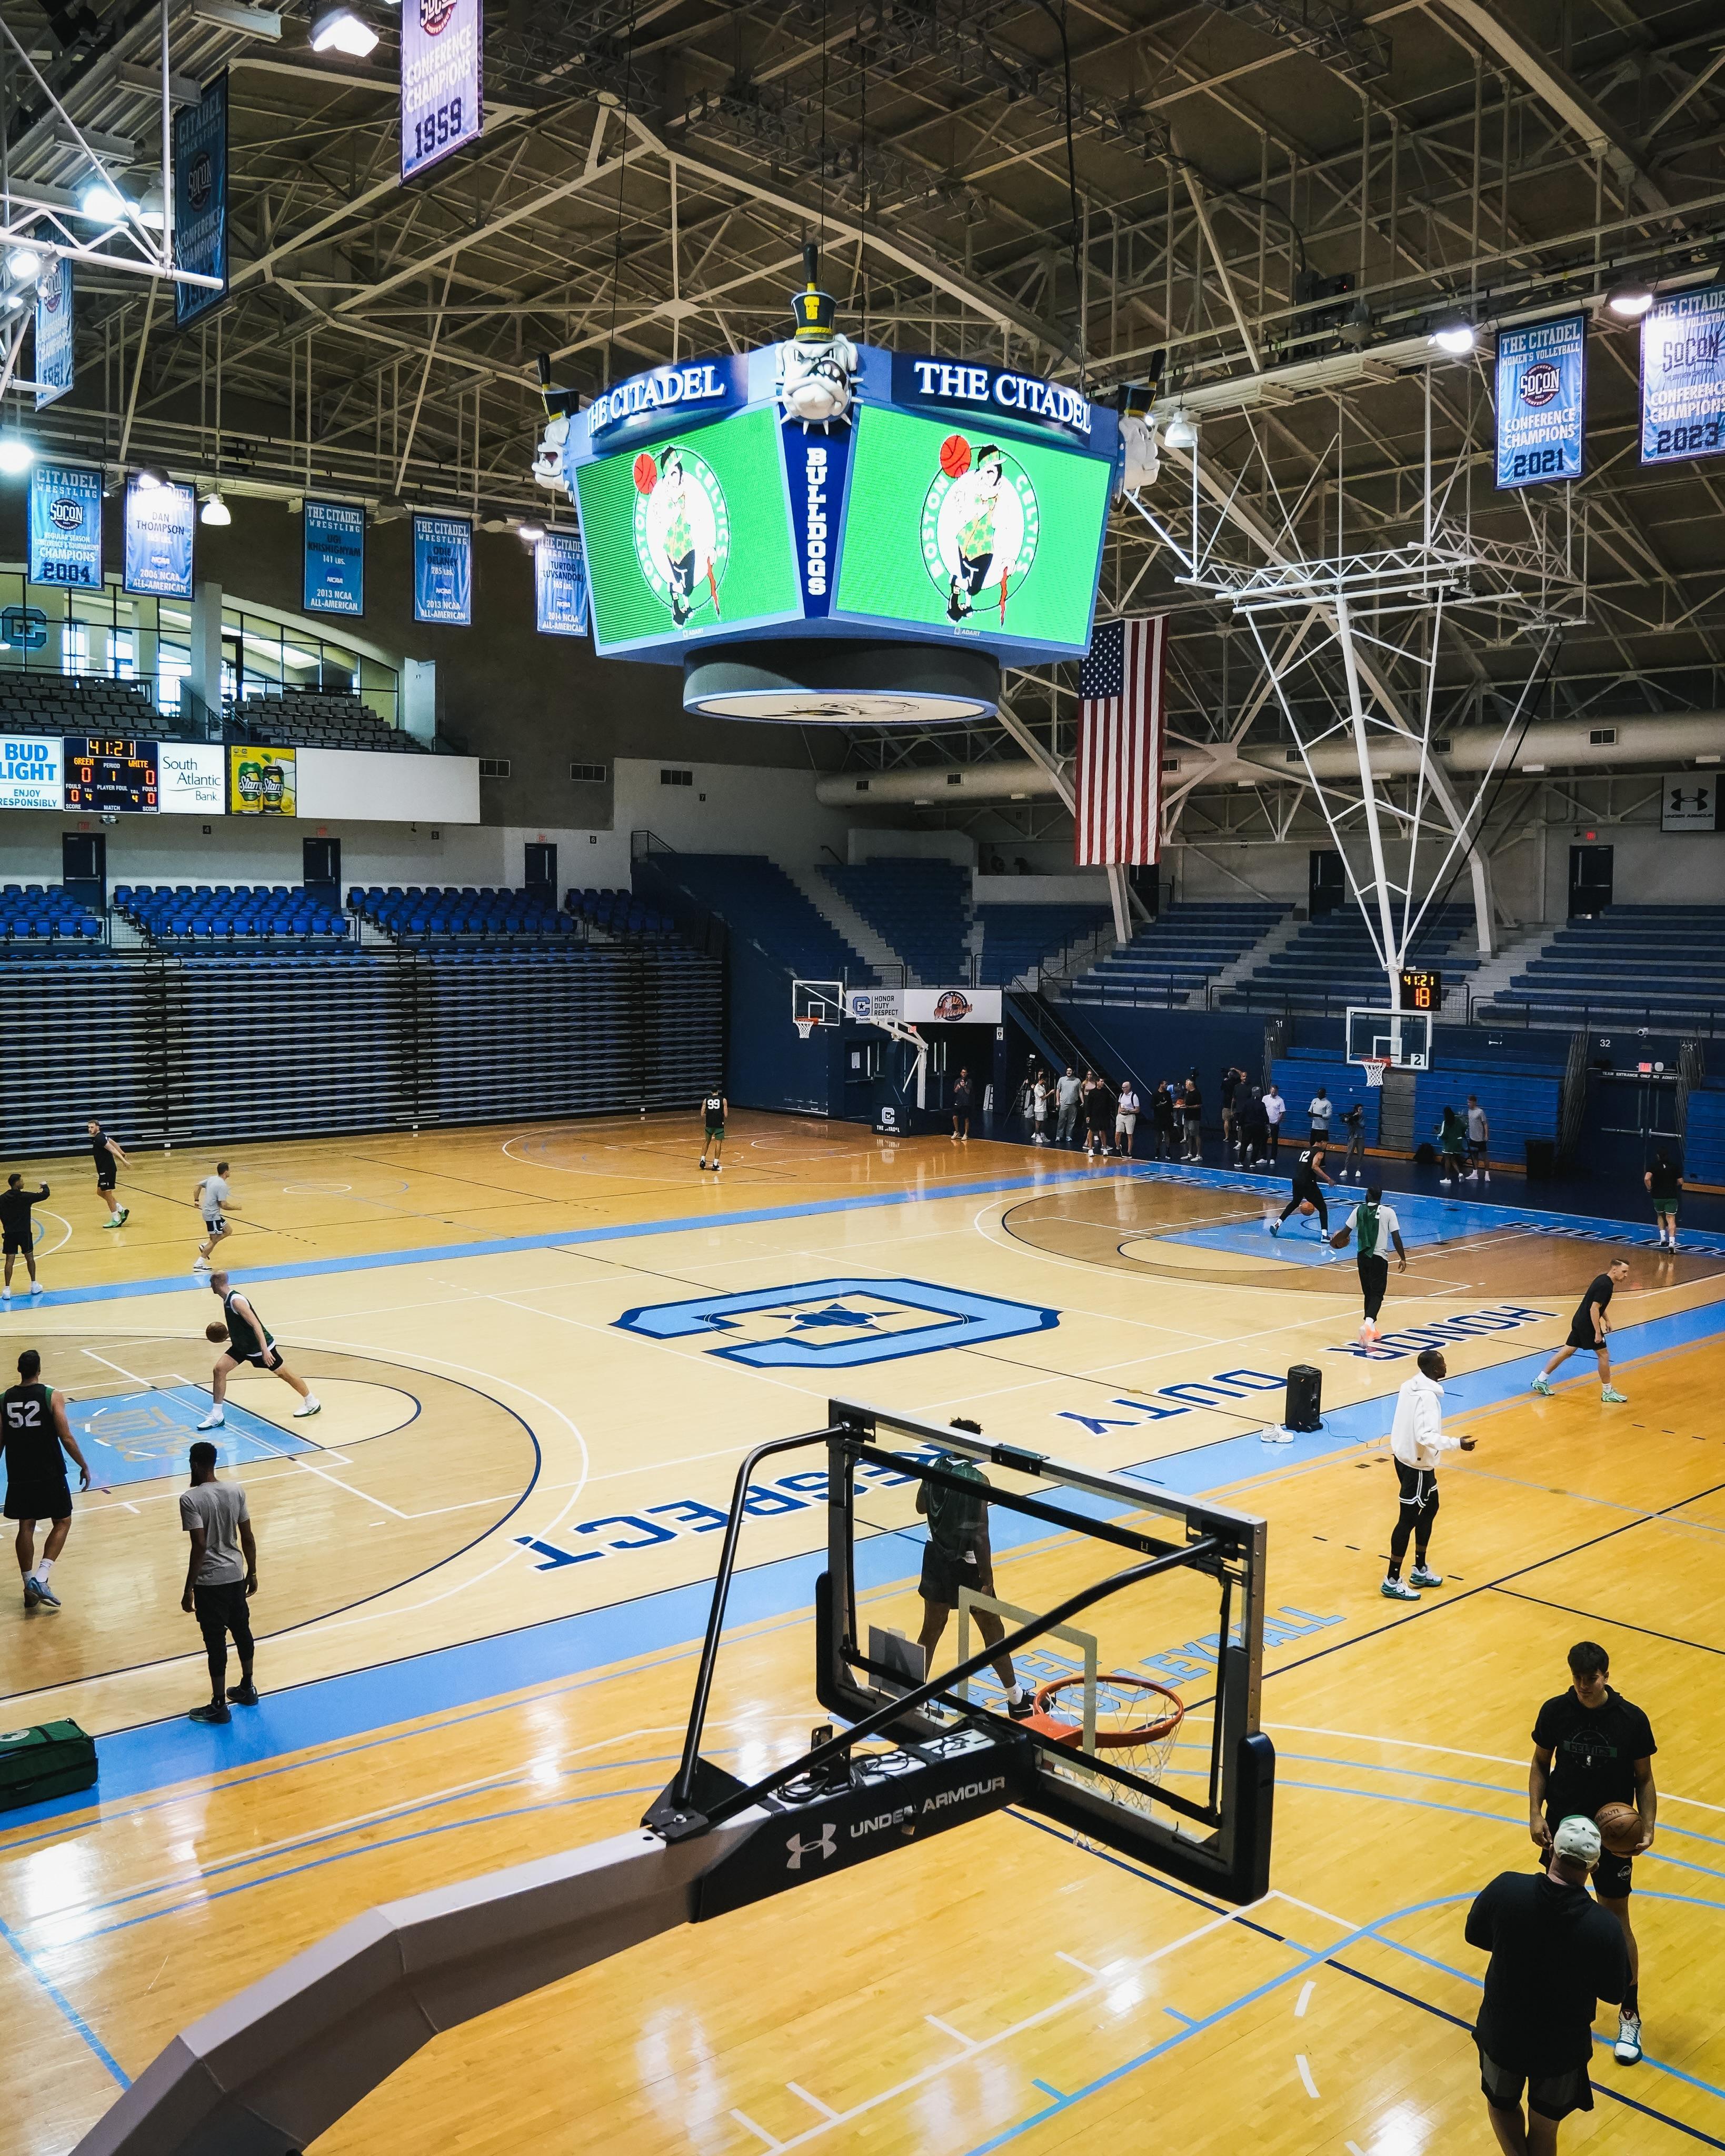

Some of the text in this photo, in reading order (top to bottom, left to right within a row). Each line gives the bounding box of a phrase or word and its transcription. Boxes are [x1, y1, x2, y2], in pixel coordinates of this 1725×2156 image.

[406, 25, 472, 87] CONFERENCE
[406, 52, 472, 113] CHAMPIONS
[415, 97, 462, 158] 1959
[182, 206, 221, 247] CONFERENCE
[182, 228, 221, 270] CHAMPIONS
[1502, 323, 1580, 355] THE CITADEL
[1502, 342, 1580, 367] WOMEN'S VOLLEYBALL
[587, 365, 725, 438] THE CITADEL
[914, 361, 1092, 435] THE CITADEL
[1504, 407, 1576, 433] CONFERENCE
[1504, 423, 1575, 448] CHAMPIONS
[1657, 422, 1719, 454] 2023
[1514, 448, 1564, 477] 2021
[36, 468, 97, 489] CITADEL
[37, 483, 97, 498] WRESTLING
[152, 512, 169, 522] DAN
[307, 505, 362, 524] THE CITADEL
[806, 447, 827, 596] BULLDOGS
[136, 520, 184, 535] THOMPSON
[310, 519, 360, 533] WRESTLING
[416, 520, 468, 537] THE CITADEL
[636, 461, 730, 592] BOSTON CELTICS
[922, 474, 1039, 579] BOSTON CELTICS
[44, 532, 68, 542] REGULAR
[327, 534, 342, 544] UGI
[418, 533, 467, 545] WRESTLING
[540, 536, 583, 552] THE CITADE
[39, 547, 96, 562] CHAMPIONS
[323, 554, 333, 563] 141
[427, 555, 458, 567] DELANEY
[43, 562, 91, 583] 2004
[431, 566, 442, 575] 285
[551, 561, 576, 572] TURTOG
[139, 568, 180, 582] 2006 NCAA
[132, 578, 186, 593] ALL-AMERICAN
[553, 580, 563, 588] 165
[317, 588, 352, 600] 2013 NCAA
[311, 598, 358, 611] ALL-AMERICAN
[426, 600, 461, 611] 2013 NCAA
[421, 609, 466, 620] ALL-AMERICAN
[548, 612, 579, 623] 2014 NCAA
[542, 621, 584, 632] ALL-AMERICAN
[5, 743, 48, 762] BUD
[89, 741, 133, 756] 41:21
[74, 757, 94, 766] GREEN
[163, 756, 197, 771] South
[0, 762, 57, 781] LIGHT
[81, 767, 91, 783] 0
[112, 771, 116, 782] 1
[145, 770, 155, 785] 0
[177, 772, 221, 785] Atlantic
[239, 775, 262, 795] Starry
[263, 778, 283, 796] Starry
[71, 790, 79, 802] 0
[147, 793, 155, 804] 0
[196, 791, 218, 801] Bank
[1403, 975, 1434, 987] 41:21
[1415, 987, 1430, 1007] 18
[1600, 1039, 1611, 1047] 32
[1414, 1054, 1422, 1066] 2
[707, 1099, 720, 1110] 99
[1299, 1151, 1311, 1163] 12
[1132, 1171, 1217, 1185] THE
[1320, 1305, 1564, 1362] HONOR
[1051, 1368, 1289, 1437] DUTY
[6, 1400, 42, 1428] 52
[922, 1776, 1005, 1814] ARMOUR
